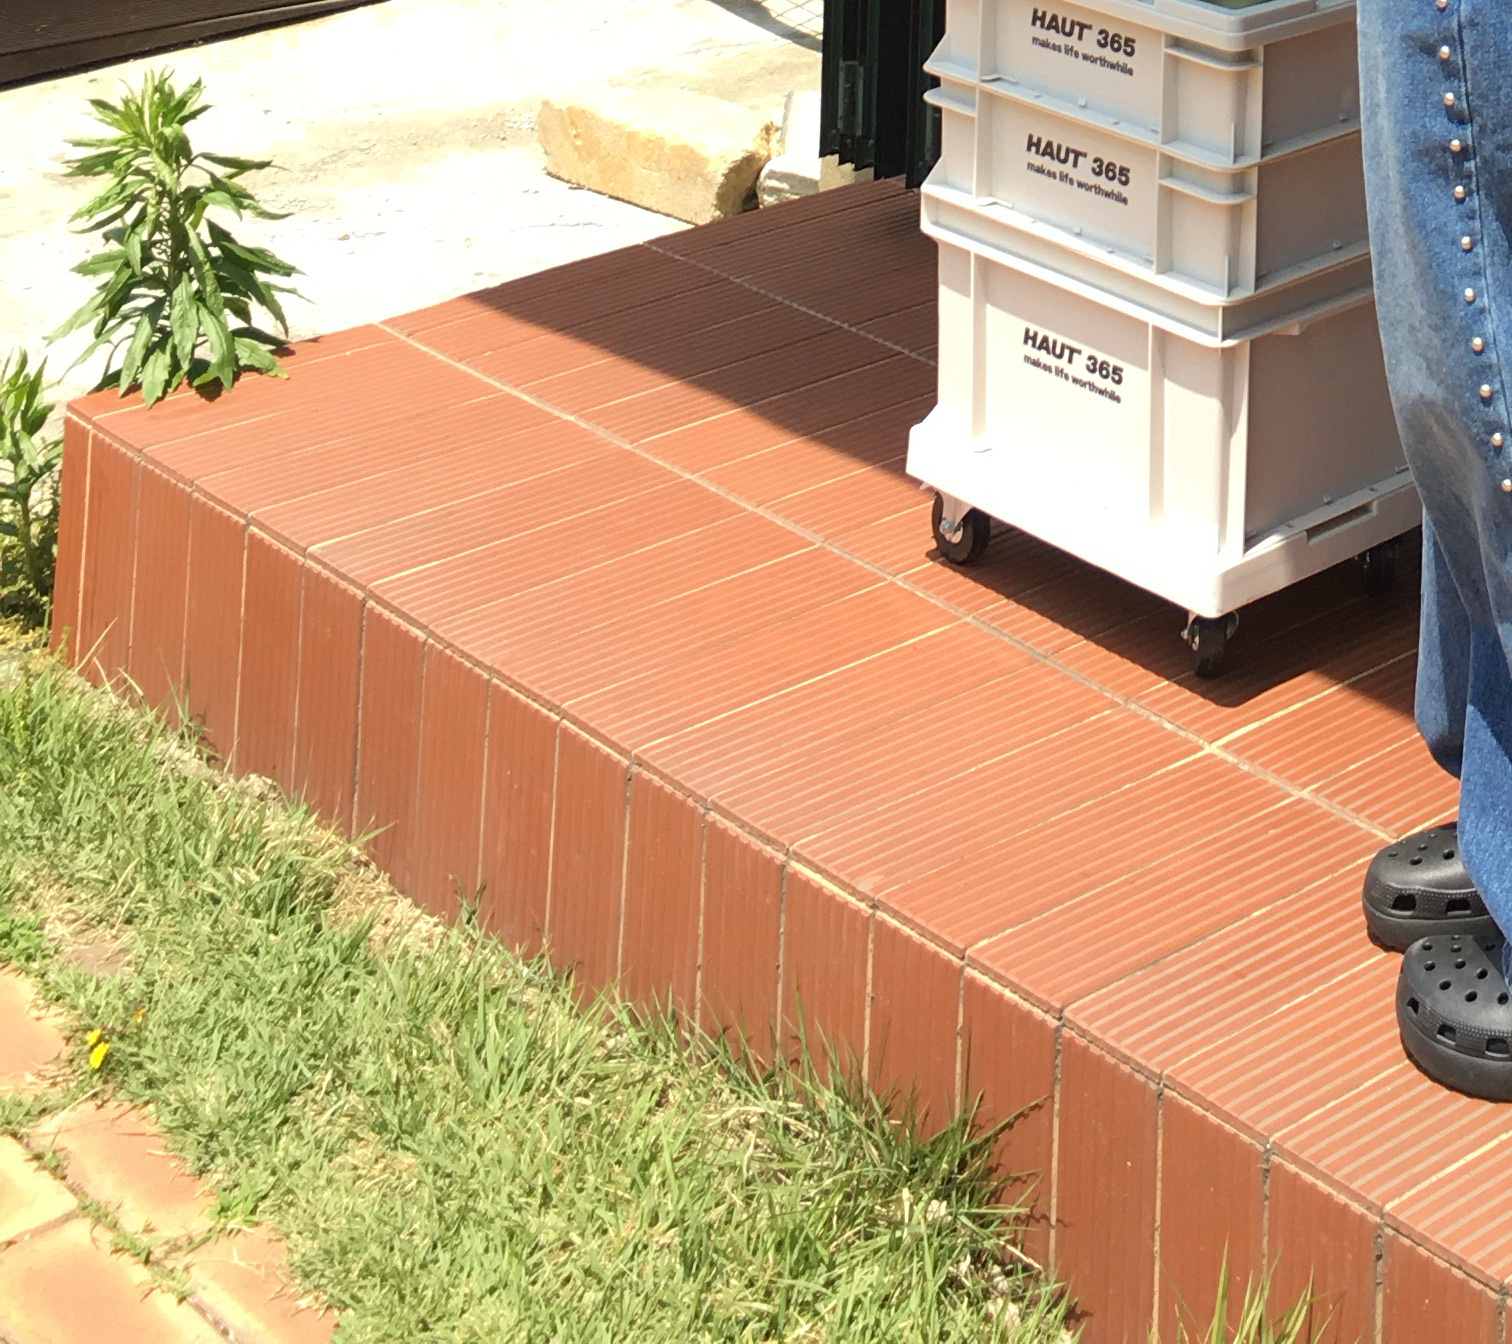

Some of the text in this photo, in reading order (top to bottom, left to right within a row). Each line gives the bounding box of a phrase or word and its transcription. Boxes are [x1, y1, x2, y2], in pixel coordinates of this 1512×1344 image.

[1031, 34, 1134, 76] makes life worthwhile
[1097, 29, 1136, 57] 365
[1027, 160, 1128, 205] makes life worthwhile
[1091, 157, 1131, 186] 365
[1023, 354, 1121, 404] makes life worthwhile
[1085, 354, 1124, 385] 365
